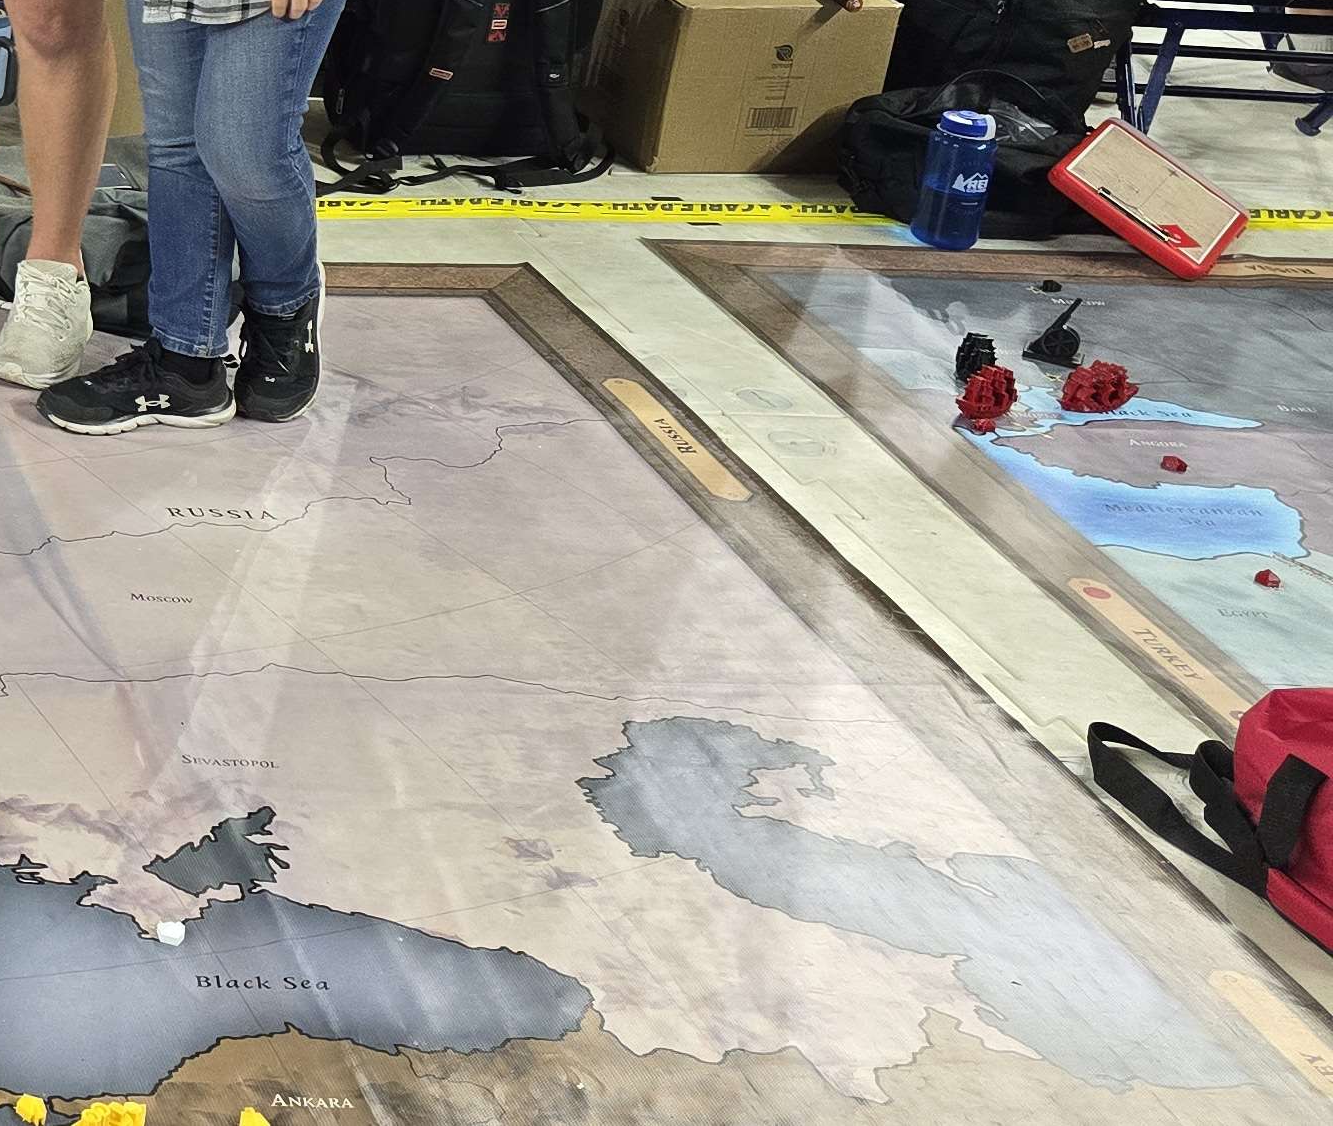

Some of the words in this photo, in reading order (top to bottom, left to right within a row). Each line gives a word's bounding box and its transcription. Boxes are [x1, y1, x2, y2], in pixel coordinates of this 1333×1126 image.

[1156, 409, 1193, 420] Sea
[1277, 403, 1317, 414] BAKU
[653, 416, 698, 456] RUSSIA
[1129, 437, 1187, 449] ANGORA
[165, 505, 279, 522] RUSSIA
[1104, 501, 1263, 518] Mediterranean
[1179, 516, 1216, 528] Sea
[130, 591, 193, 606] MOSCOW
[1217, 606, 1271, 620] EGYPT
[1131, 626, 1205, 683] TURKEY
[181, 752, 280, 771] SEVASTOPOL
[196, 974, 272, 992] Black
[283, 975, 330, 992] Sea
[271, 1092, 355, 1110] ANKARA
